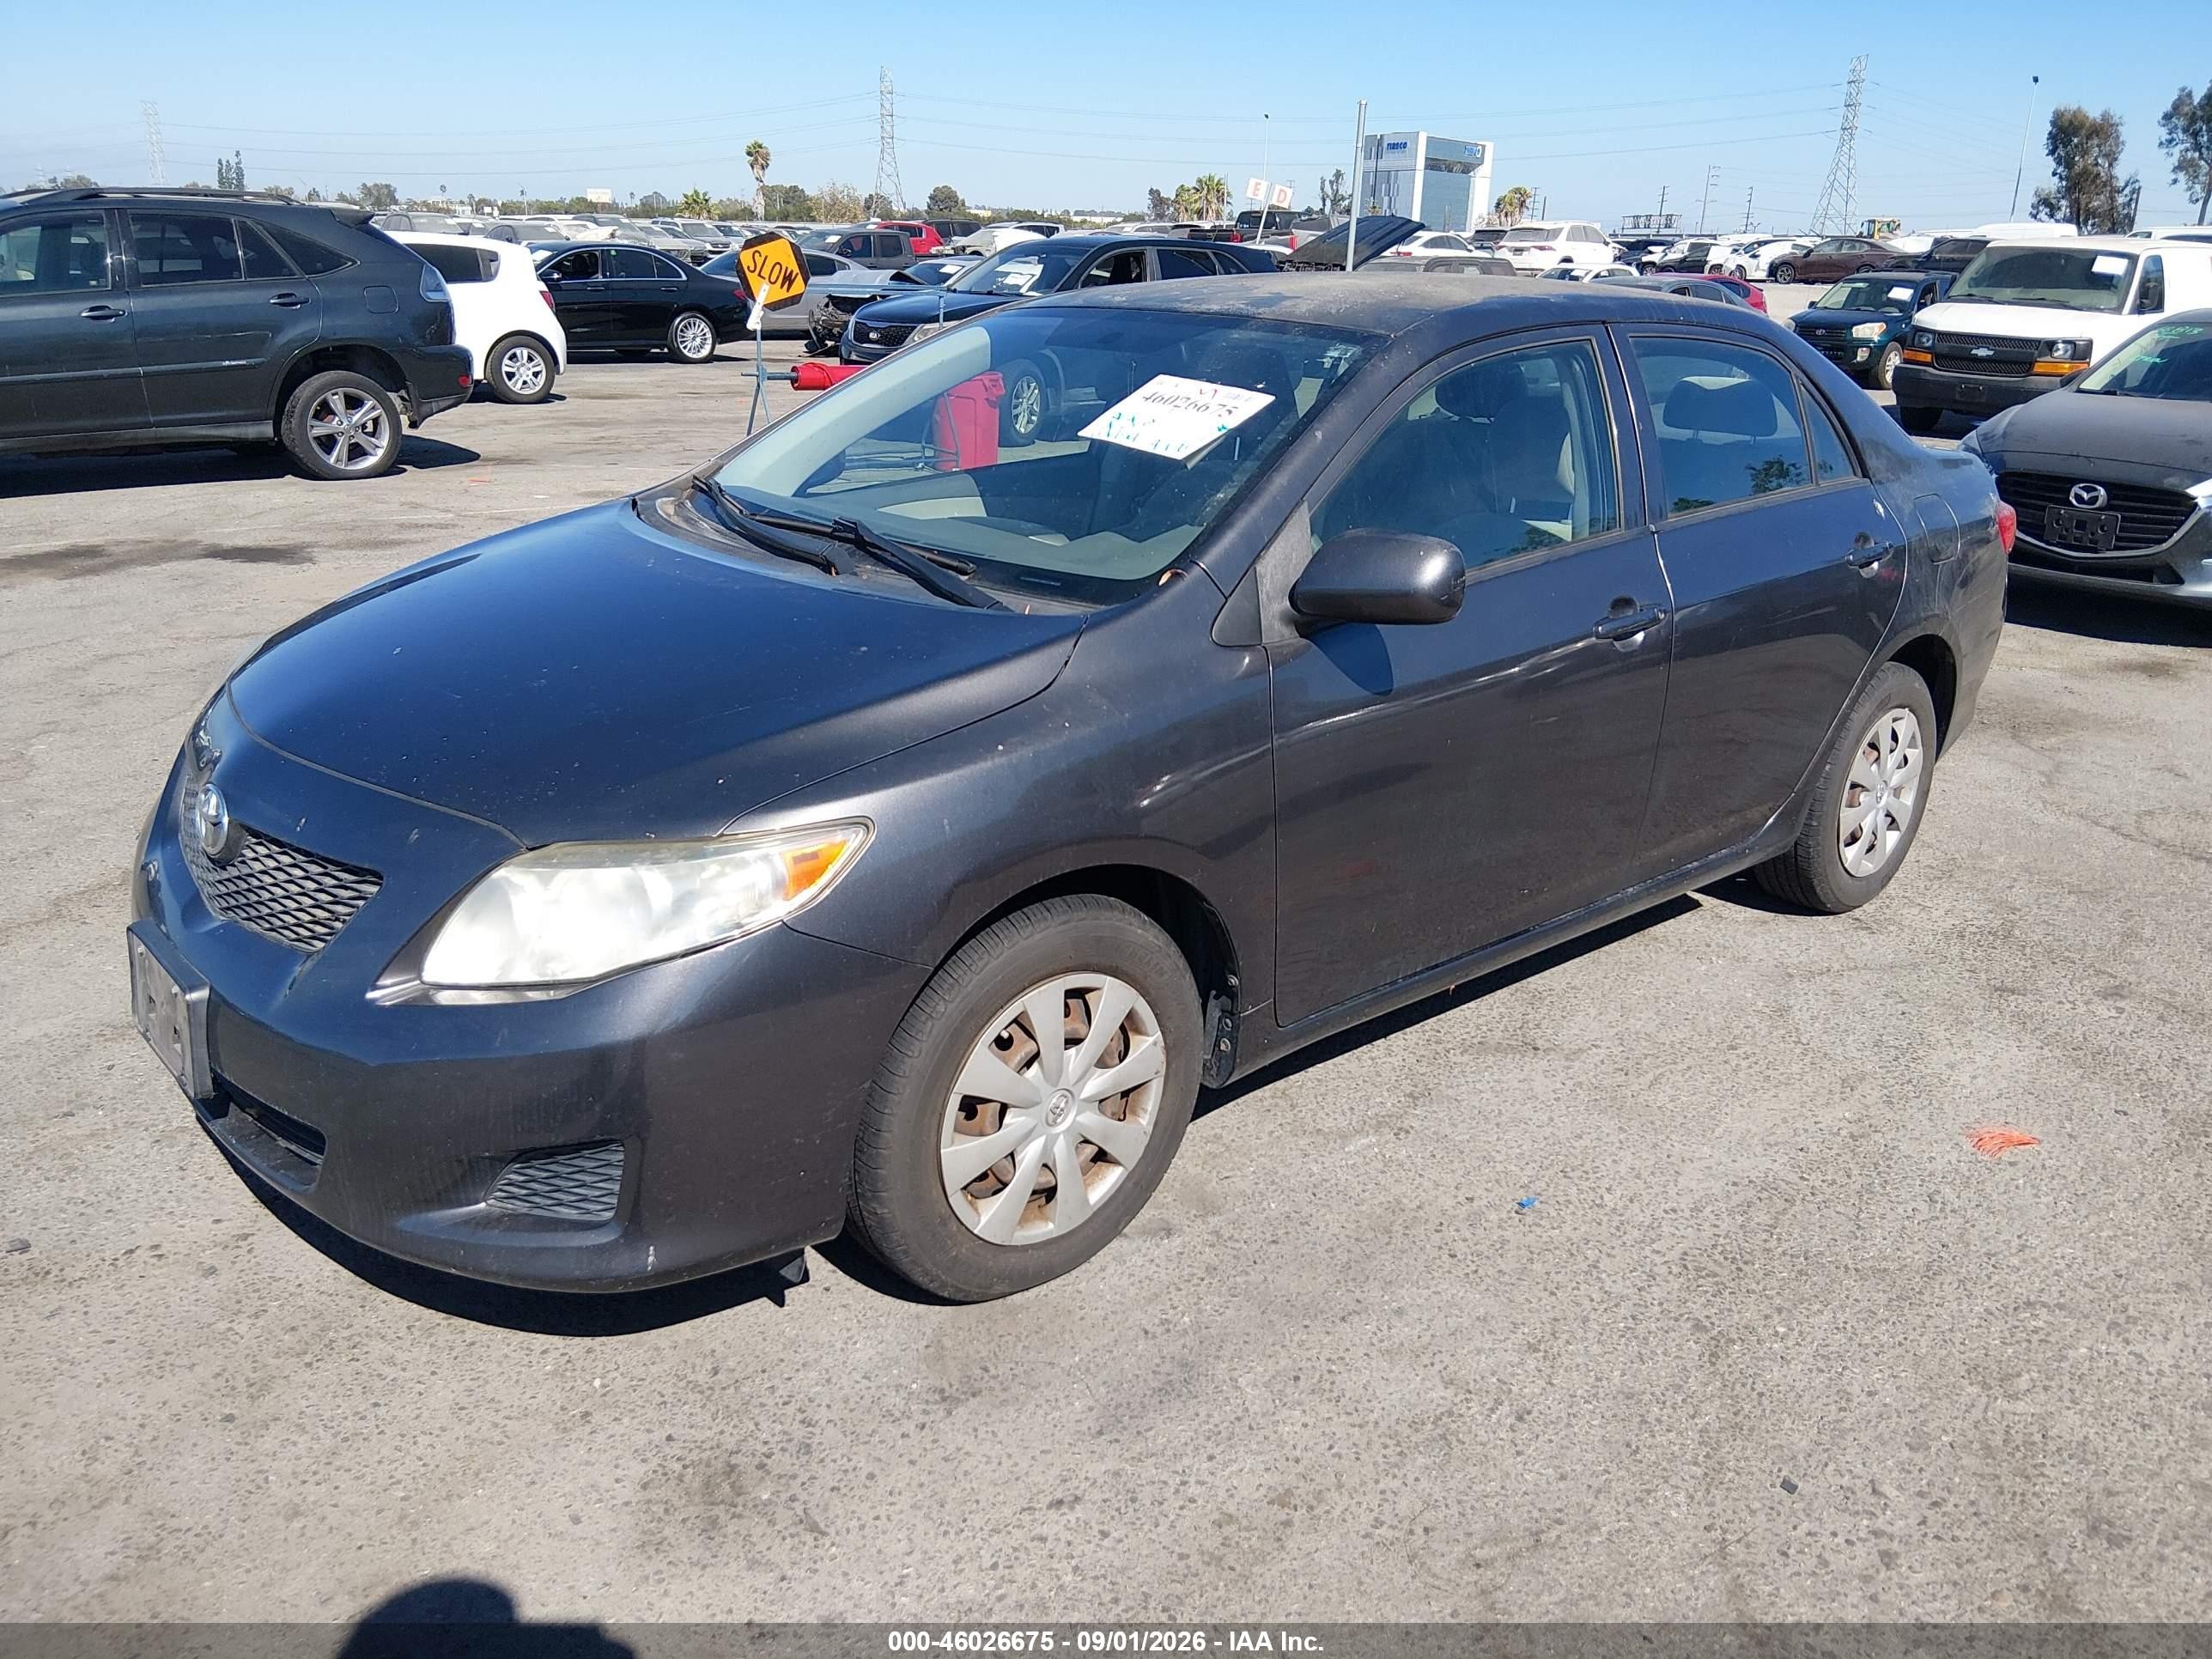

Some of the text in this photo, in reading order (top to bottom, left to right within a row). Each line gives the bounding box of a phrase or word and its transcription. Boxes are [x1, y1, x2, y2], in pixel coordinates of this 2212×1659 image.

[1252, 181, 1262, 198] E
[1277, 187, 1286, 204] D
[747, 250, 799, 293] SLOW
